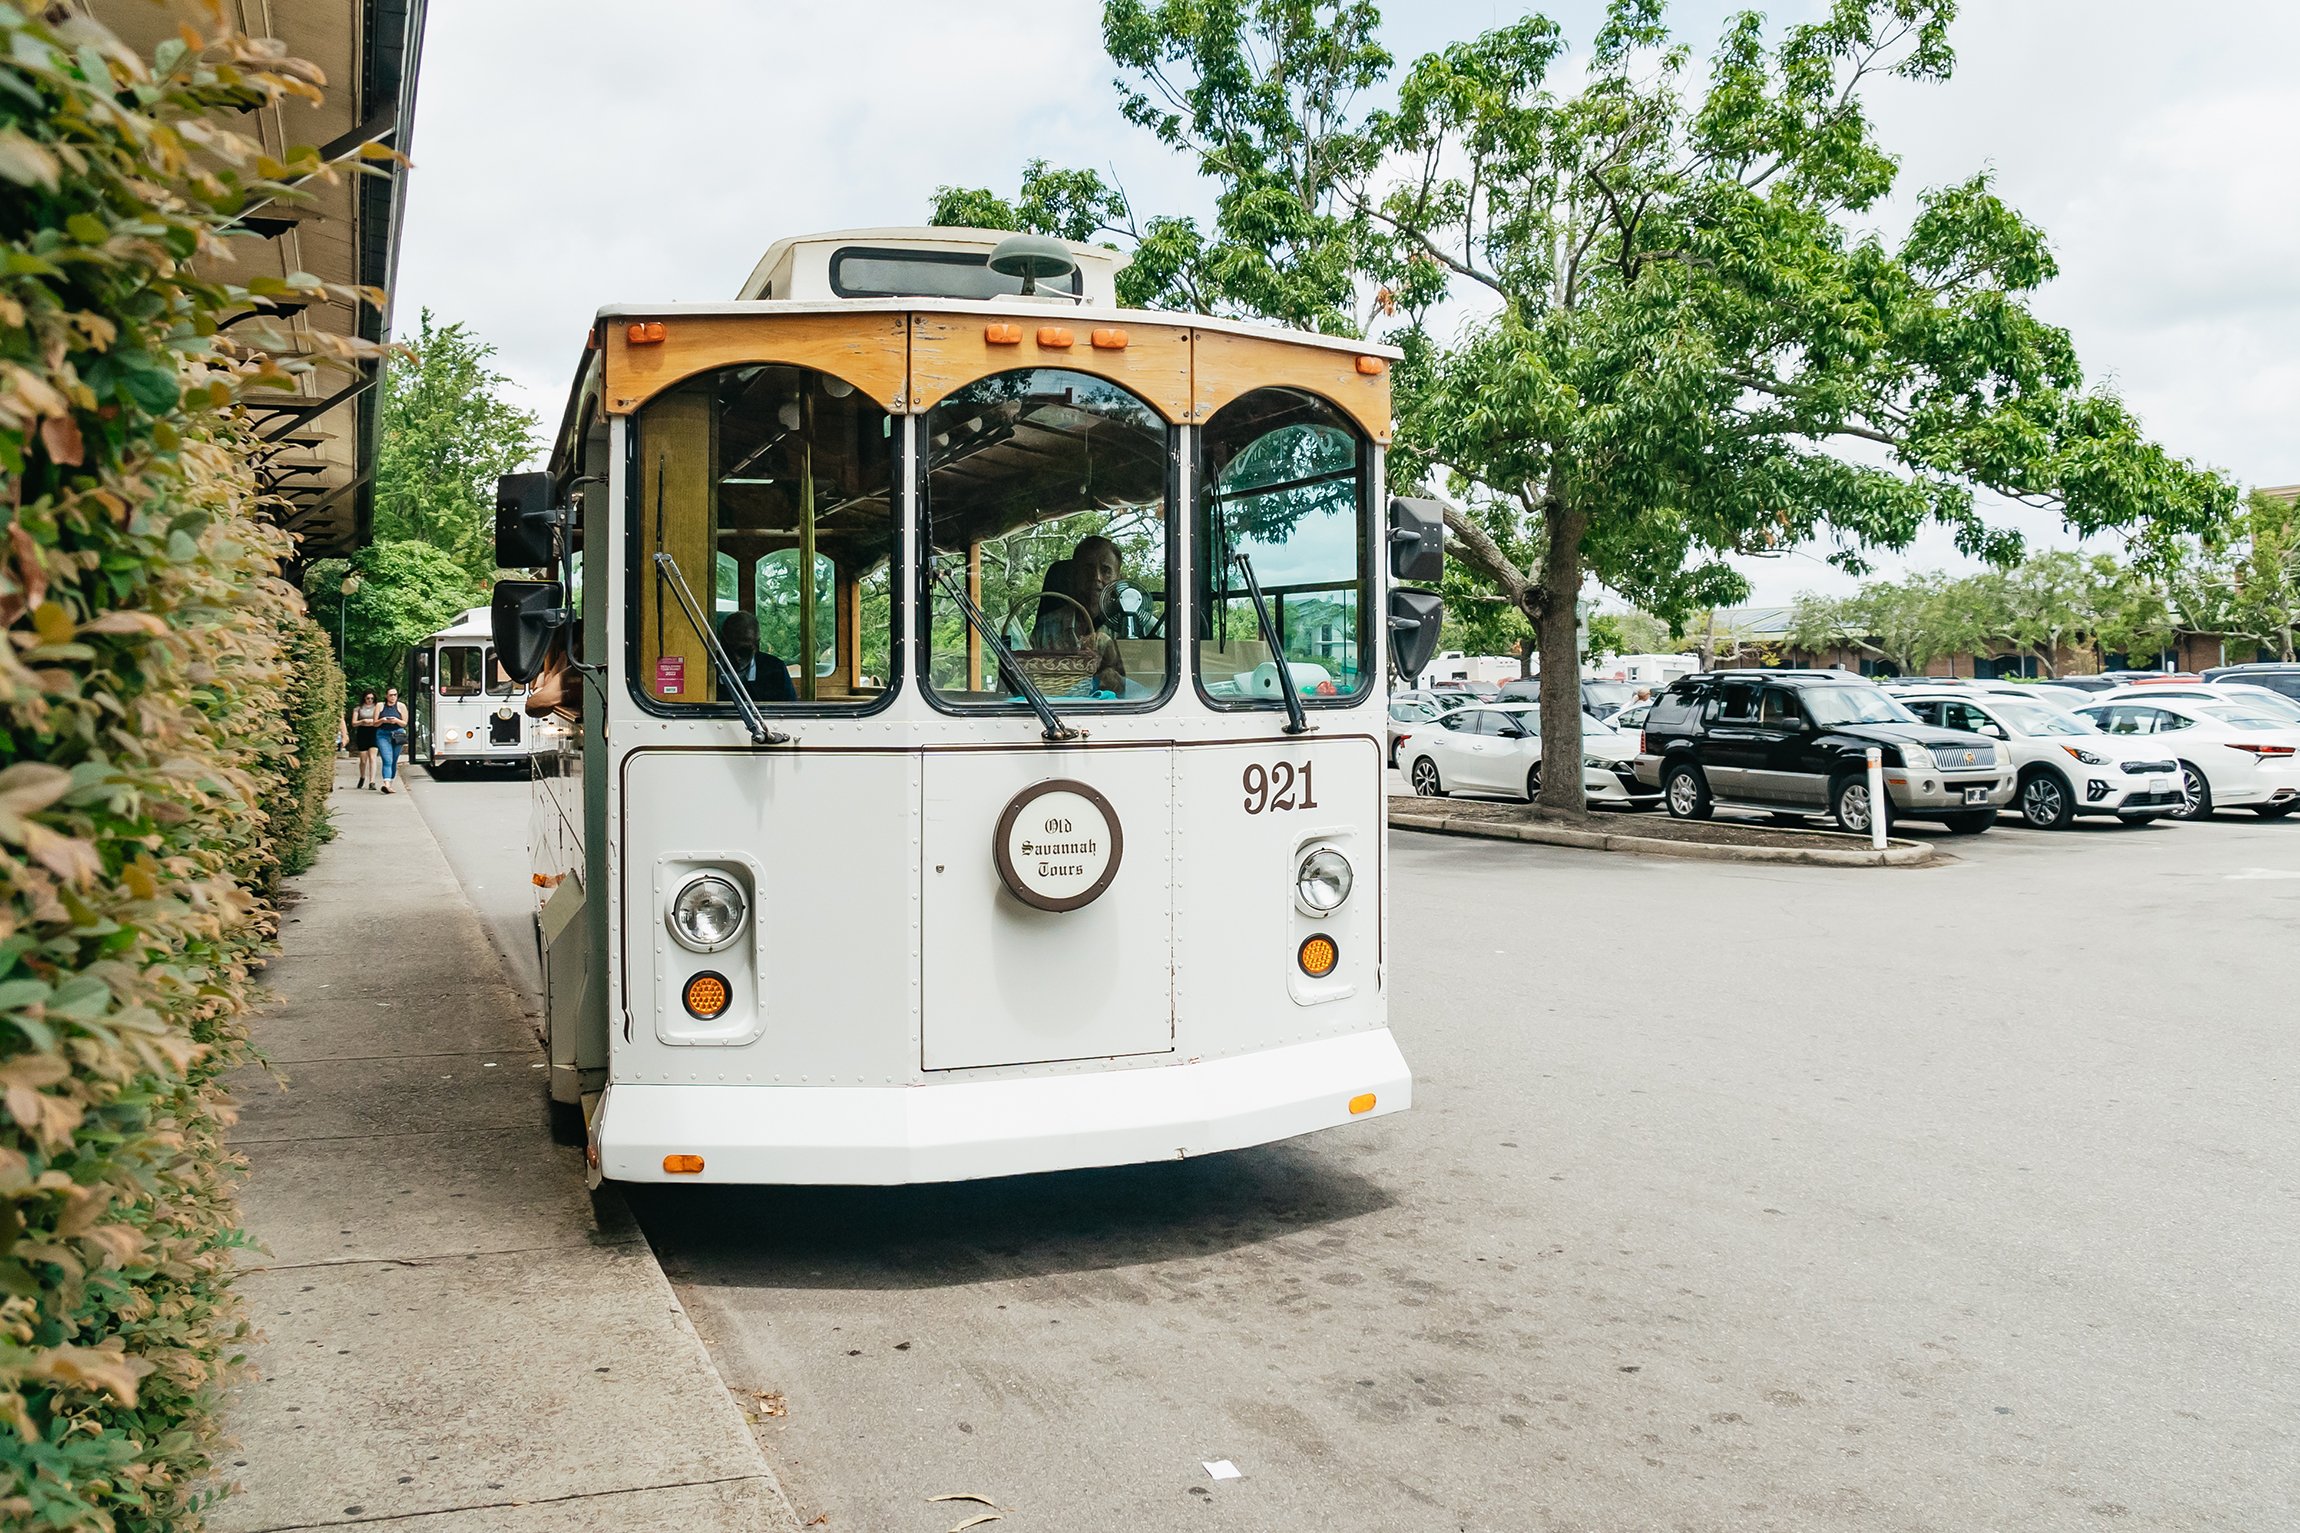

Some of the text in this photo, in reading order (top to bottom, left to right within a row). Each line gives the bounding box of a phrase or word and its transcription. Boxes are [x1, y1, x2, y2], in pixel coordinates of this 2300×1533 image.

[1242, 760, 1318, 815] 921
[1044, 818, 1072, 834] Old
[1021, 838, 1096, 856] Savannah
[1038, 861, 1083, 877] Tours
